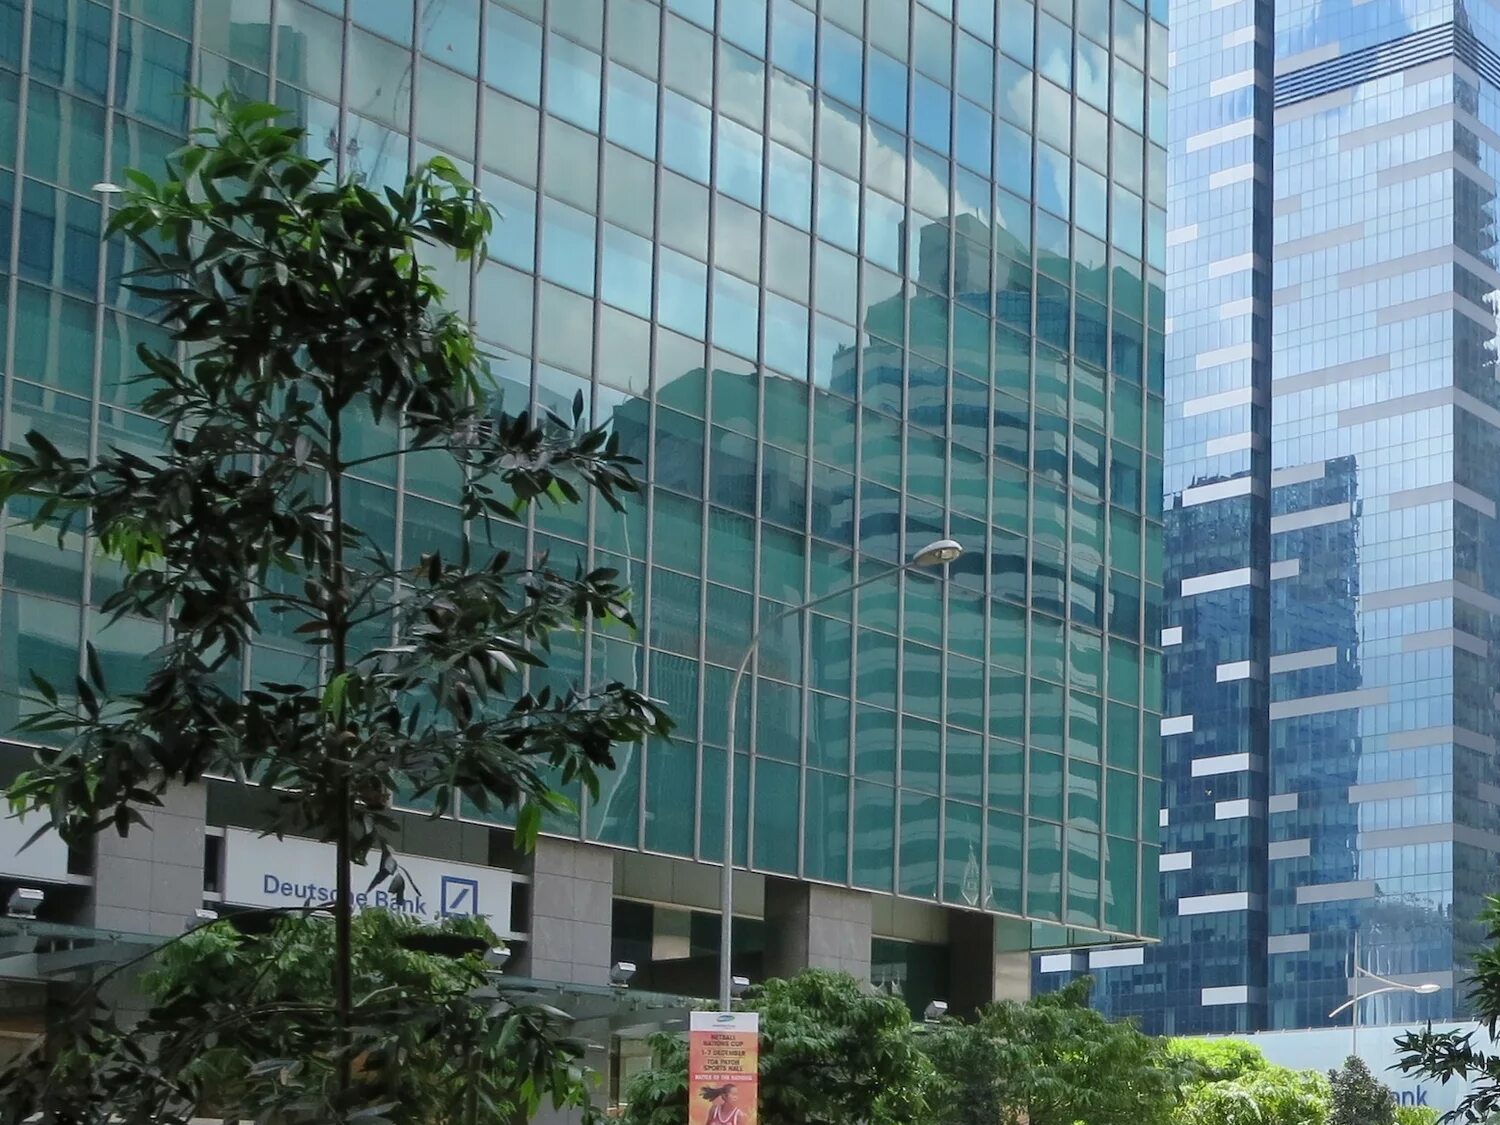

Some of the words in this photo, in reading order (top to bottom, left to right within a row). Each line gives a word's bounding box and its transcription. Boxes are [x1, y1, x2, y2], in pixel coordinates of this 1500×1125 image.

[263, 874, 368, 908] Deutsce
[375, 890, 427, 914] Bank
[1391, 1085, 1427, 1106] ank
